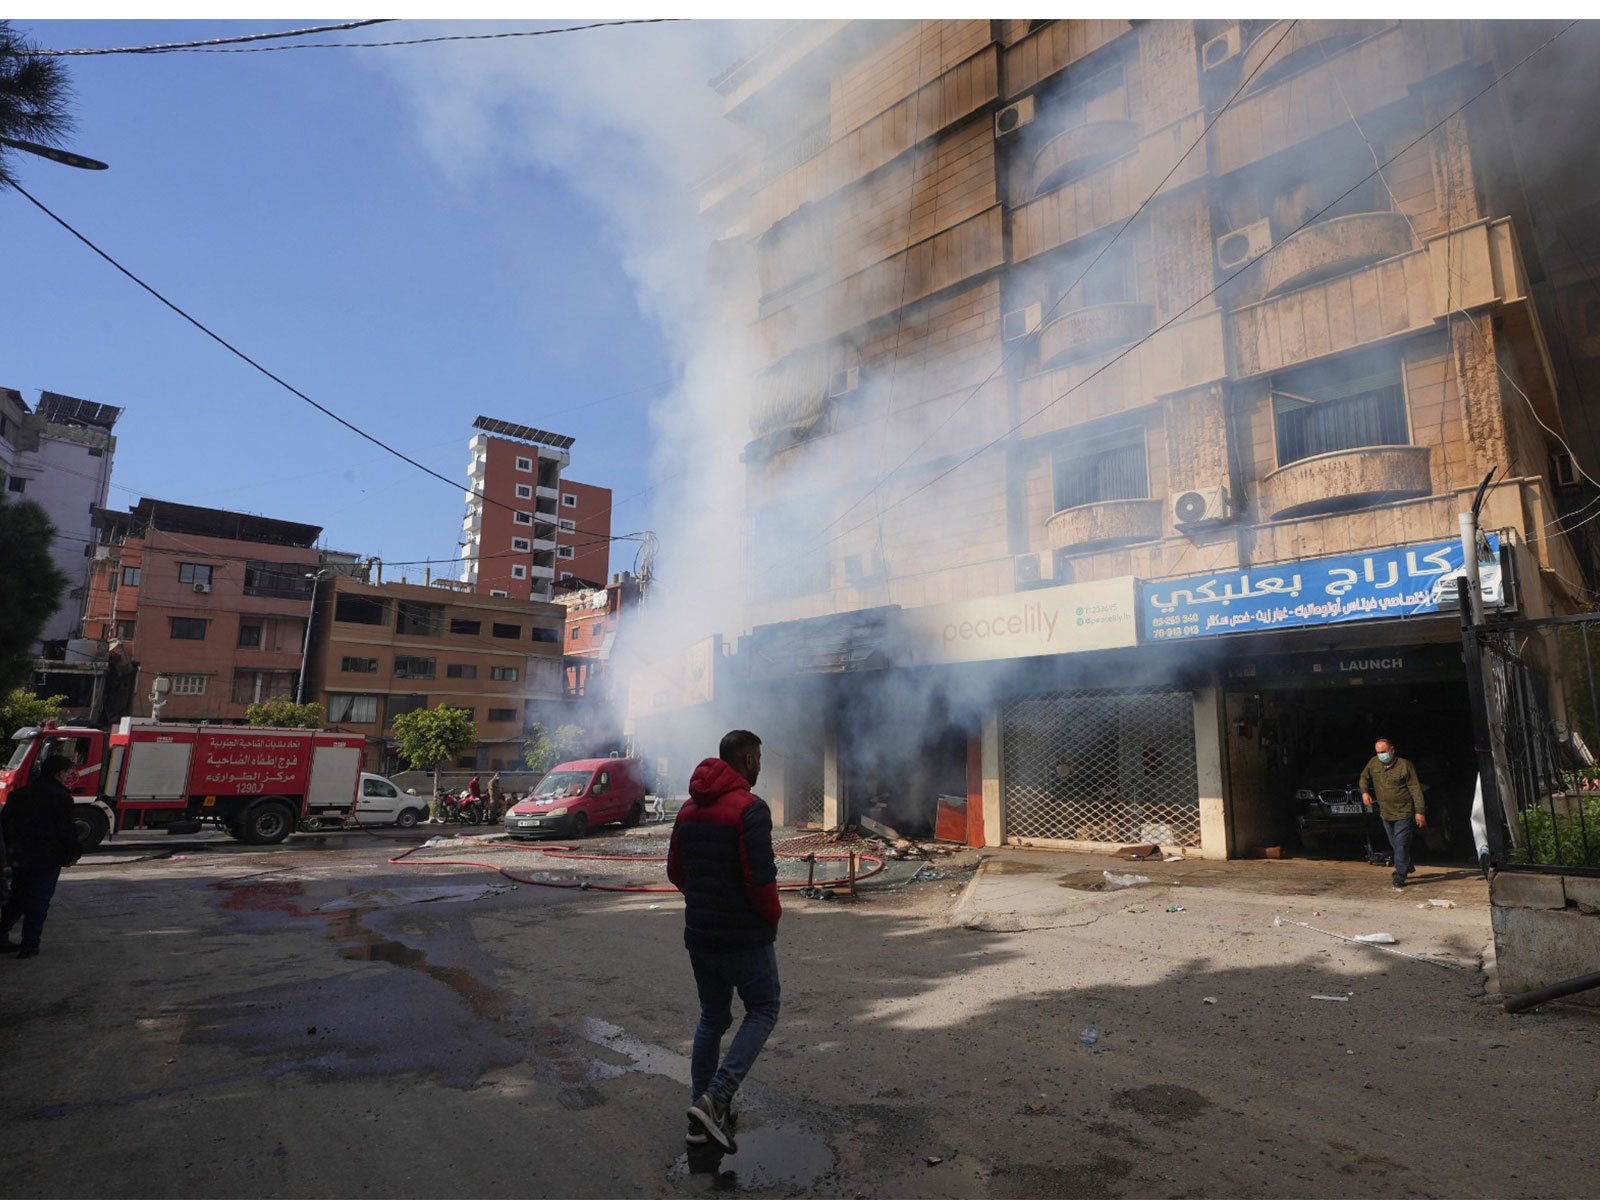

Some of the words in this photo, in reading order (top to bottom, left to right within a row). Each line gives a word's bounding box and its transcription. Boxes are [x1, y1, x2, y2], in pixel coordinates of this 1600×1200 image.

[1325, 547, 1452, 595] كاراج
[1151, 574, 1302, 613] بعلبكي
[1230, 611, 1250, 626] فحص
[1255, 608, 1271, 624] زيت
[943, 602, 1059, 646] peacelily
[1340, 658, 1403, 672] LAUNCH
[210, 737, 239, 749] الجنوبية
[240, 738, 264, 749] الضاحية
[207, 753, 250, 767] الضاحية
[251, 754, 278, 767] إطفاء
[278, 754, 298, 769] فوج
[263, 771, 296, 782] مركز
